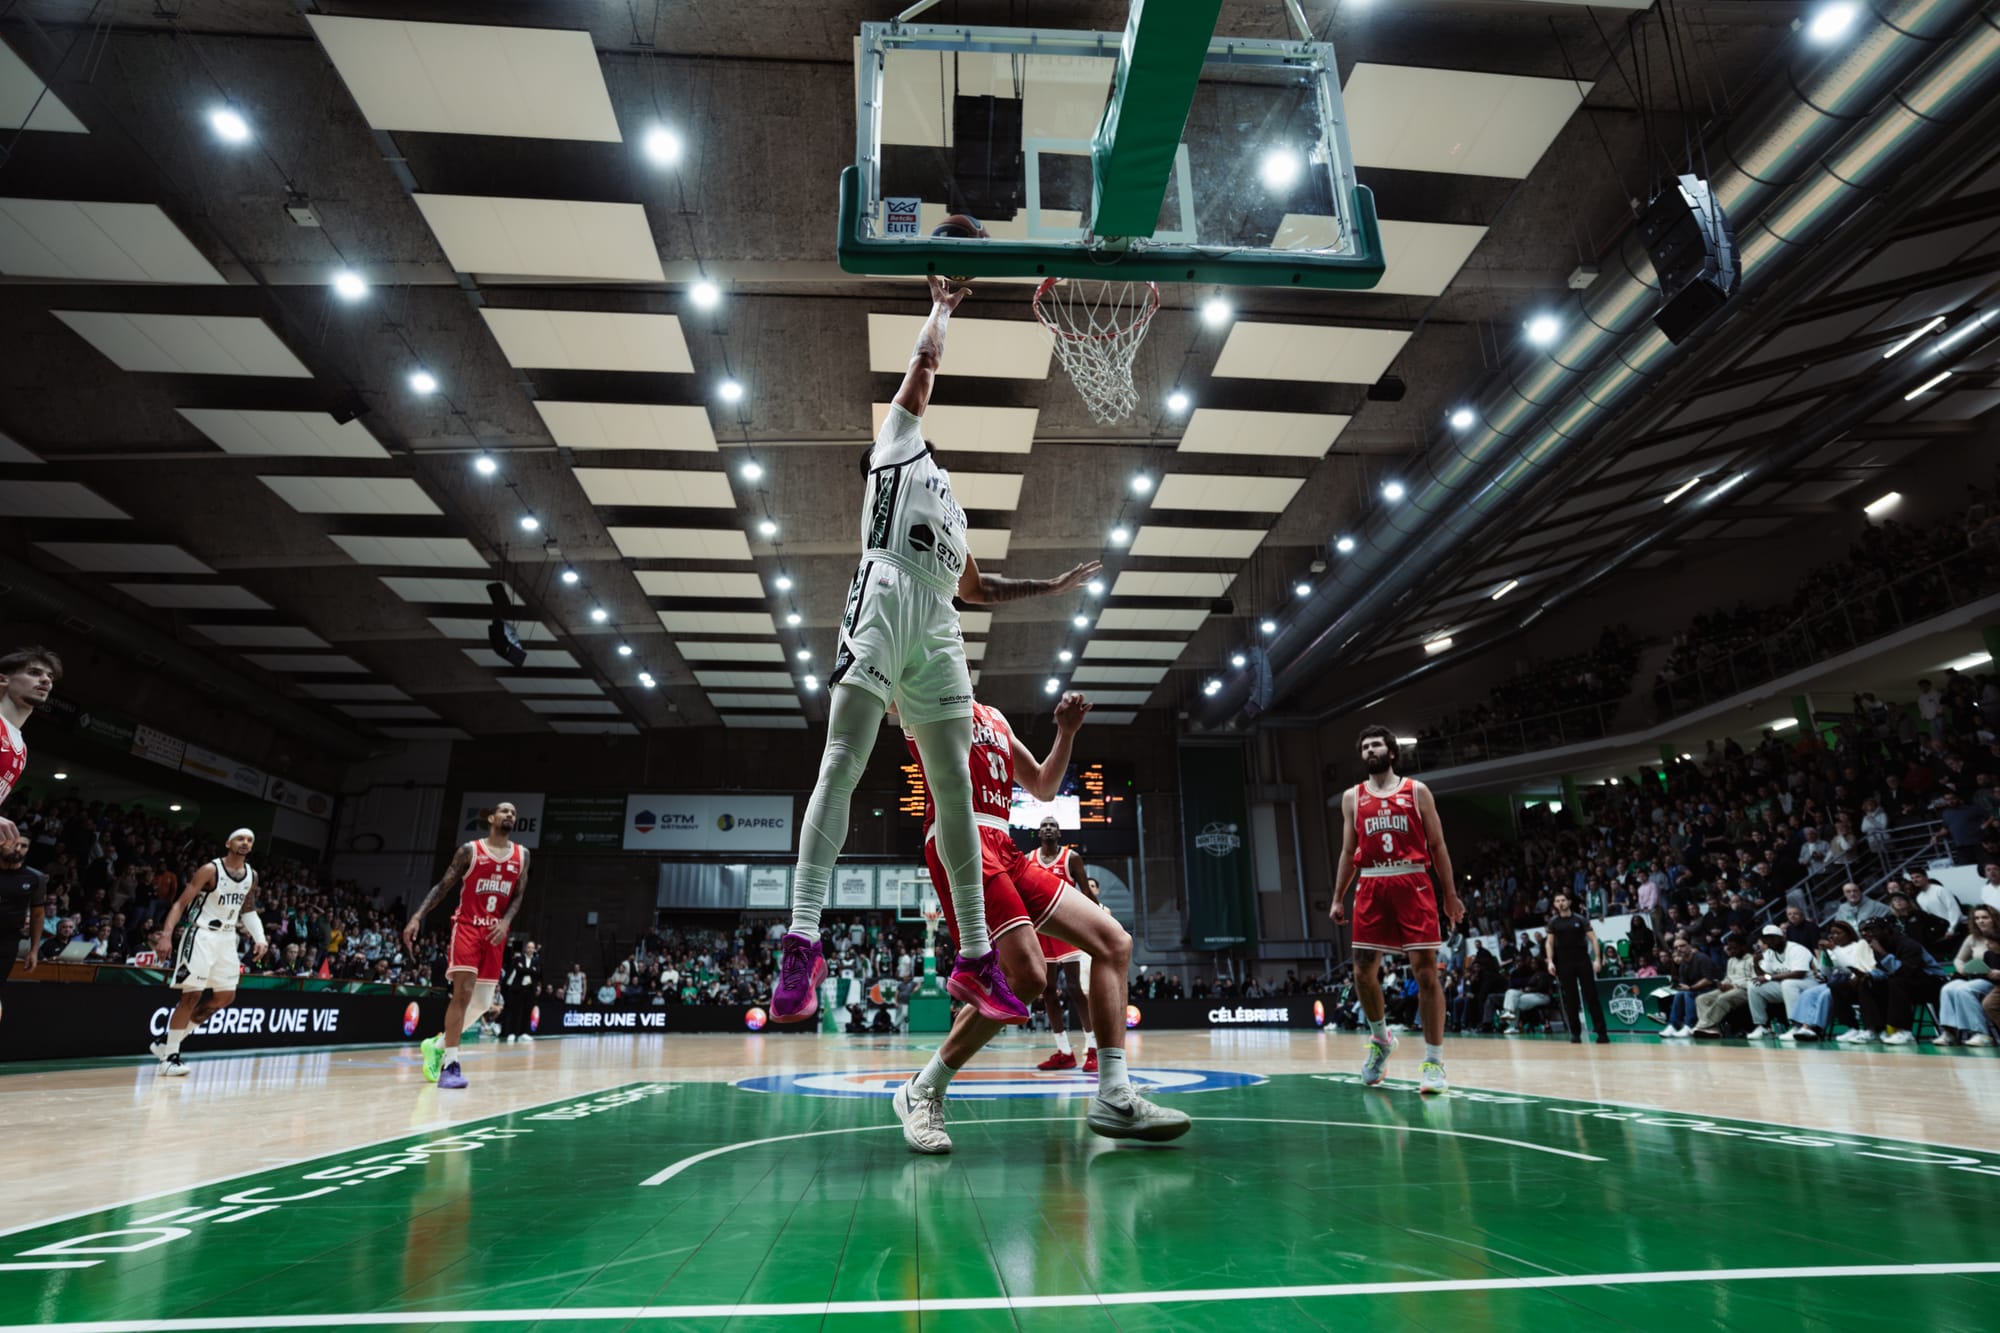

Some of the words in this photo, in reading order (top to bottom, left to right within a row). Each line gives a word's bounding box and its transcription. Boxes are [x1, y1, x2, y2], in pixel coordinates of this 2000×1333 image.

[887, 222, 917, 233] ÉLITE
[937, 541, 960, 572] GTM
[661, 814, 695, 824] GTM
[737, 818, 784, 828] PAPREC
[1364, 814, 1409, 836] CHALON
[1381, 832, 1394, 853] 3
[475, 878, 513, 896] CHALON
[486, 895, 498, 913] 8
[268, 1008, 307, 1034] UNE
[312, 1008, 340, 1033] VIE
[603, 1012, 637, 1028] UNE
[639, 1012, 667, 1028] VIE
